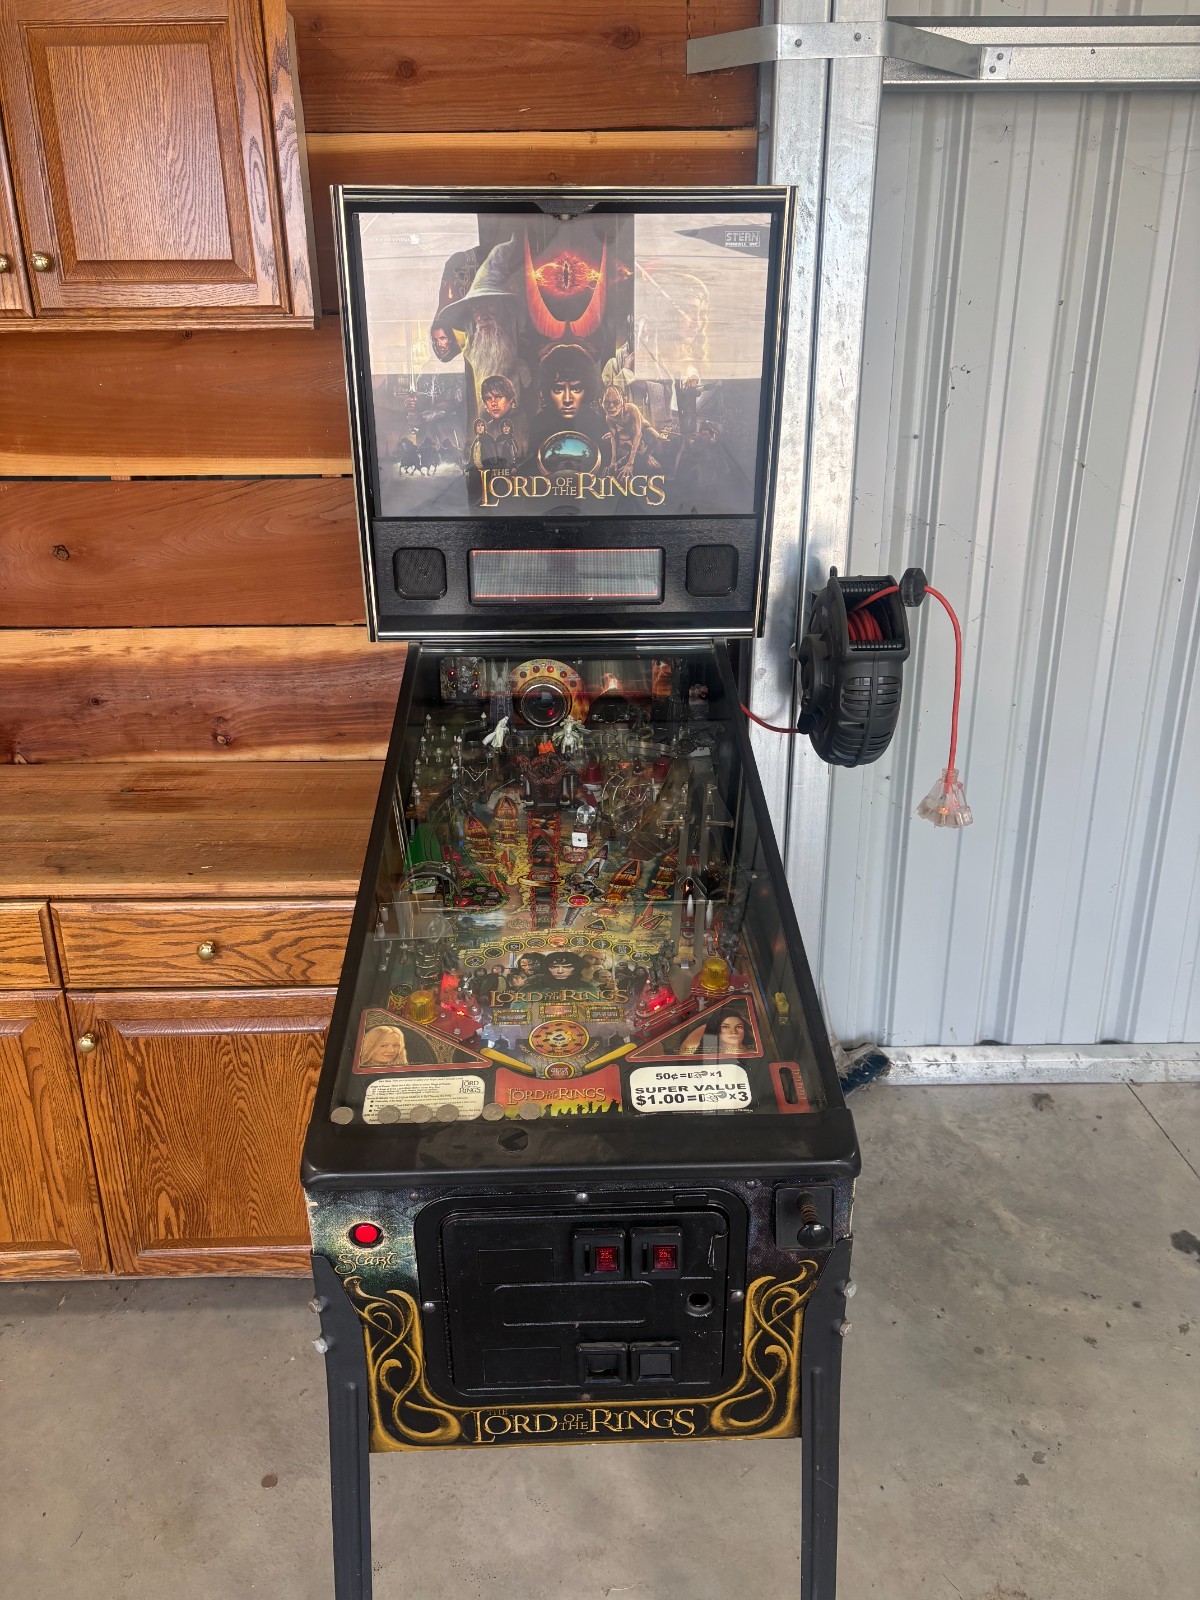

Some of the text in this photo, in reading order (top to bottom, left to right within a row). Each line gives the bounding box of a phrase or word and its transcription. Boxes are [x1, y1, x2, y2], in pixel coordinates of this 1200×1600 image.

[726, 232, 759, 242] STERN
[478, 470, 666, 506] LORD OF THE RINGS
[490, 990, 542, 1008] LORD
[560, 989, 628, 1004] RINGS
[506, 1088, 544, 1105] LORD
[558, 1087, 606, 1102] RINGS
[635, 1083, 746, 1094] SUPER VALUE
[334, 1251, 398, 1274] Start
[472, 1408, 696, 1443] LORD OF THE RINGS
